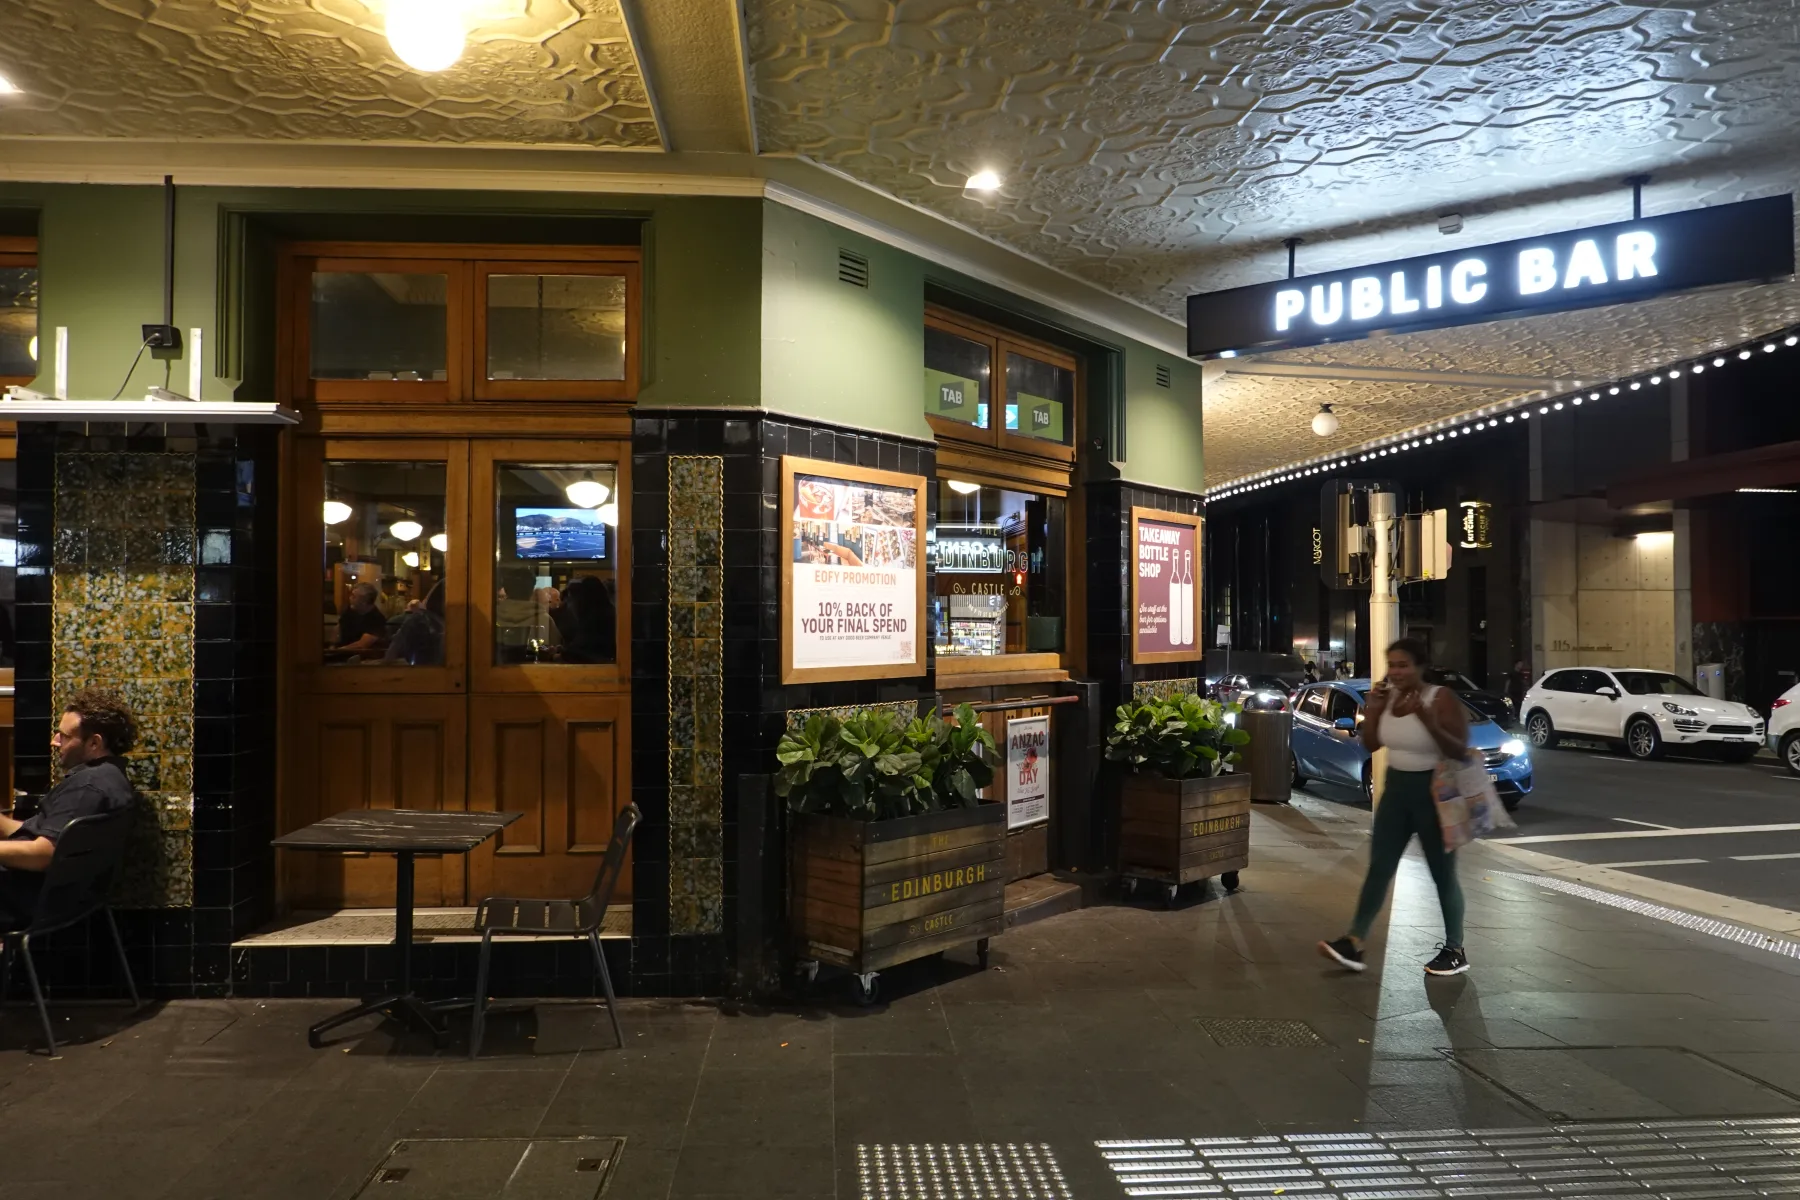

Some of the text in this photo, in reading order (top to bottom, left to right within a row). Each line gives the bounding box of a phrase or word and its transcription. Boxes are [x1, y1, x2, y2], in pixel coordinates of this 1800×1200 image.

[1274, 230, 1660, 332] PUBLIC BAR
[941, 387, 963, 405] TAB
[1033, 410, 1049, 425] TAB
[1139, 527, 1180, 545] TAKEAWAY
[1139, 545, 1169, 561] BOTTLE
[814, 570, 896, 585] EOFY PROMOTION
[1139, 563, 1161, 578] SHOP
[971, 582, 1005, 596] CASTLE
[818, 602, 893, 617] 10% BACK OF
[801, 618, 907, 633] YOUR FINAL SPEND
[1011, 731, 1044, 750] ANZAC
[1019, 768, 1038, 785] DAY
[1193, 816, 1241, 836] EDINBURGH
[892, 865, 985, 901] EDINBURGH
[924, 915, 953, 931] CASTLE
